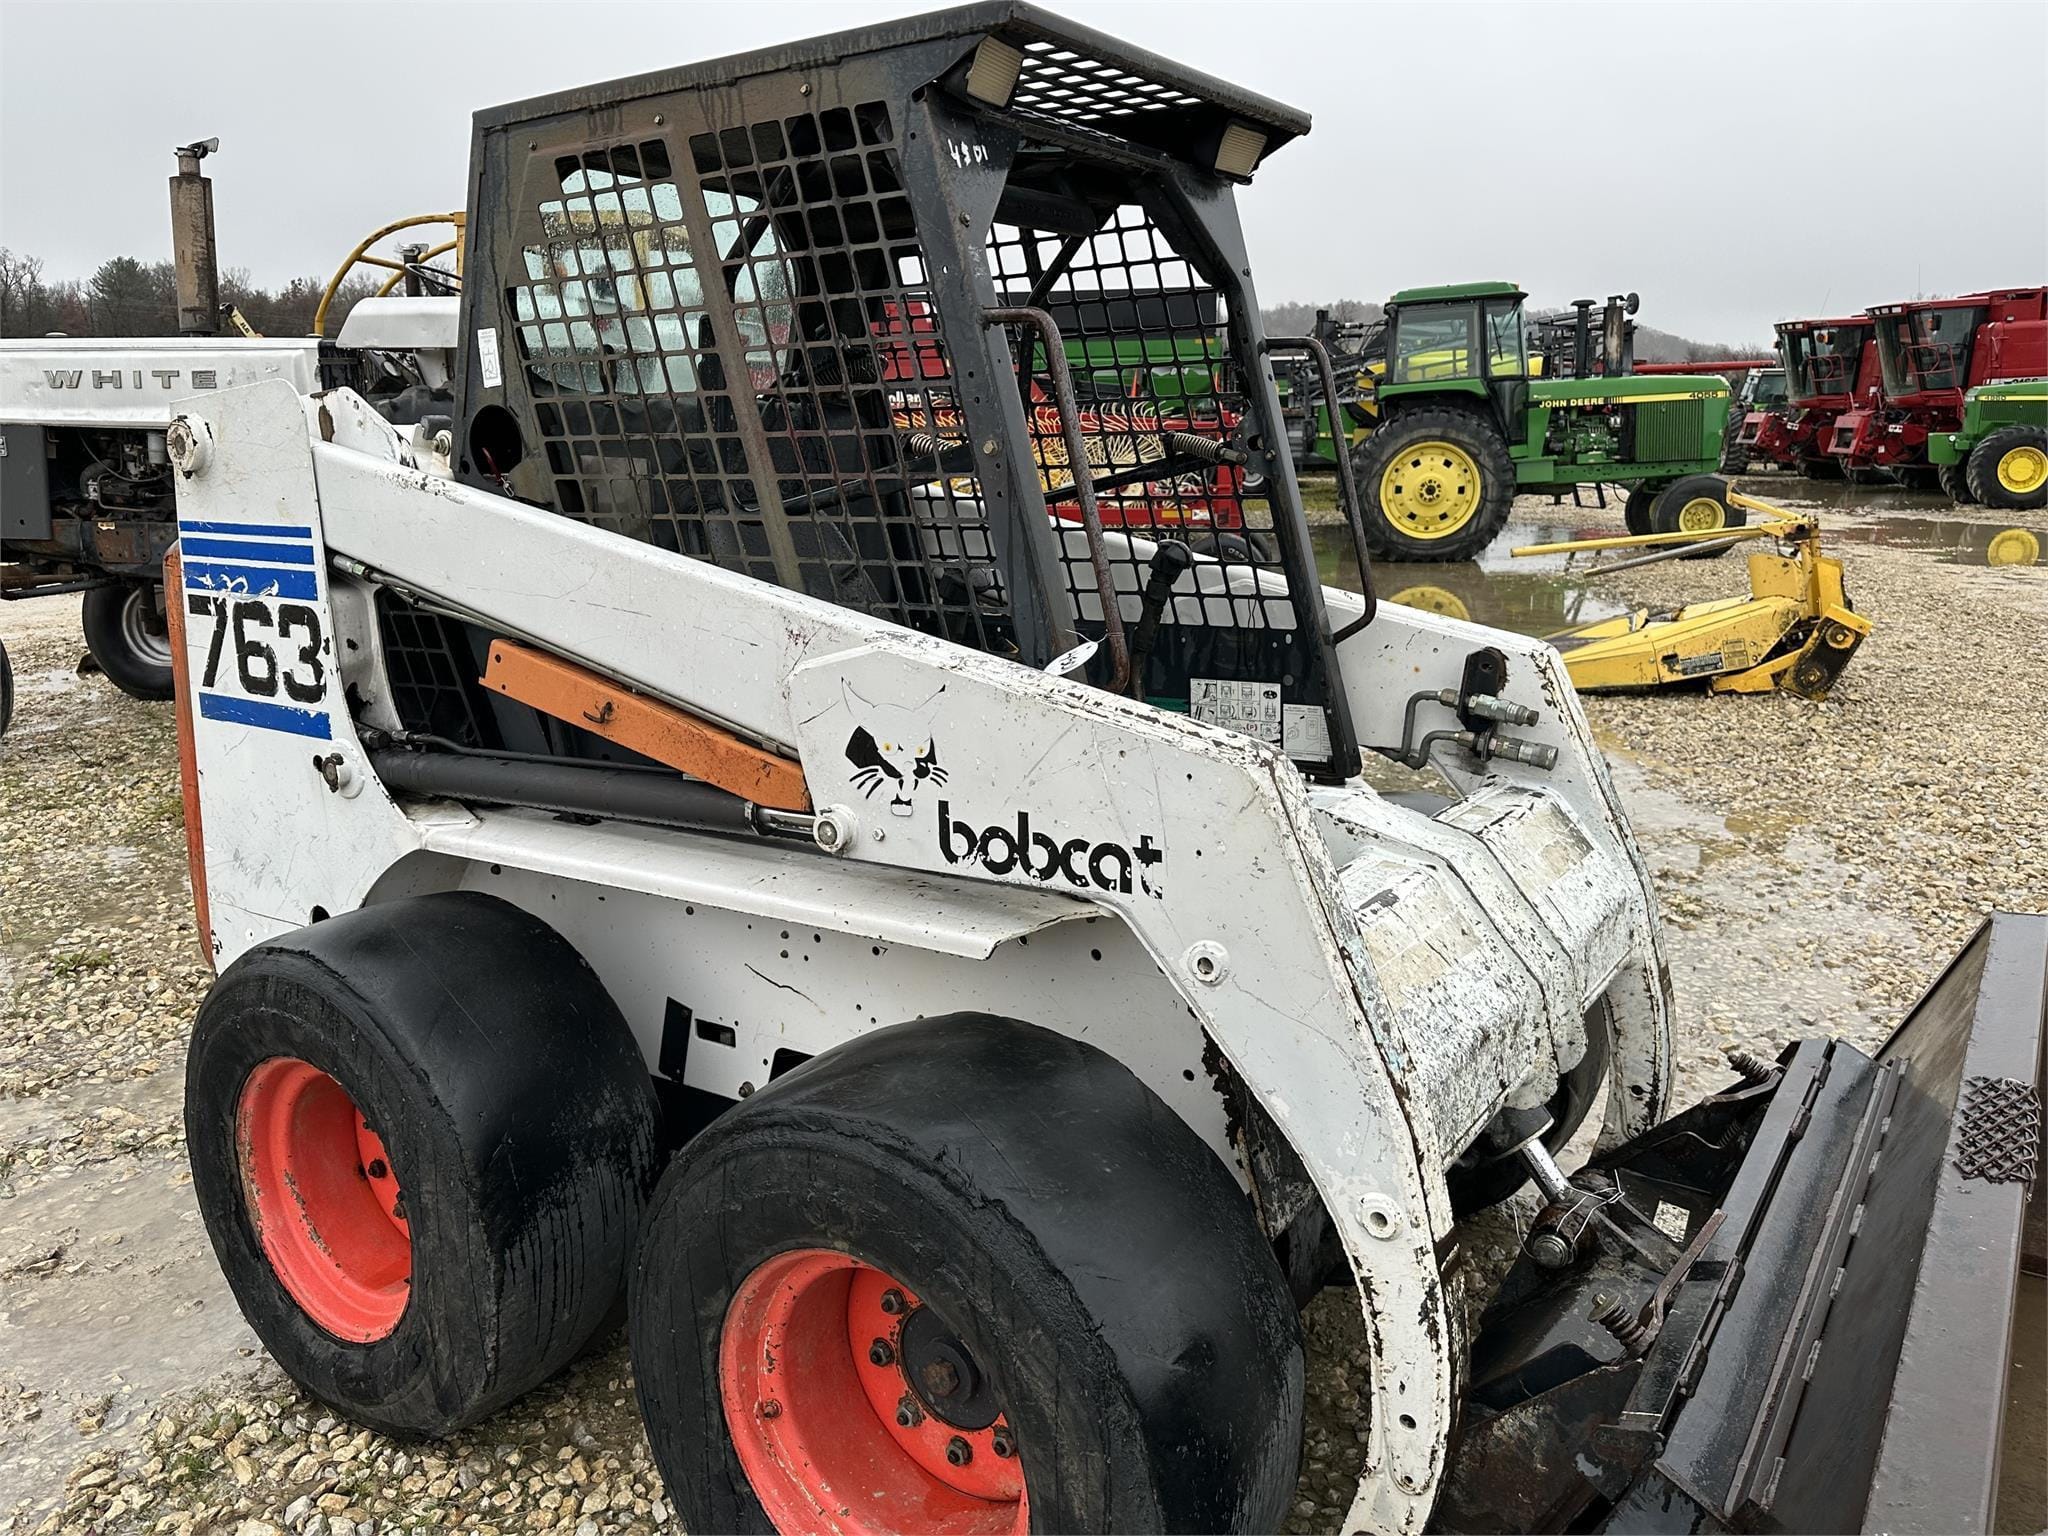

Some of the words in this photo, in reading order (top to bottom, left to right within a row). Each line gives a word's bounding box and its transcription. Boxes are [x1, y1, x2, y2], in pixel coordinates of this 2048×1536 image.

[43, 370, 217, 389] WHITE
[1539, 399, 1568, 409] JOHN
[1569, 397, 1605, 407] DEERE
[187, 593, 328, 704] 763
[938, 799, 1163, 900] bobcat
